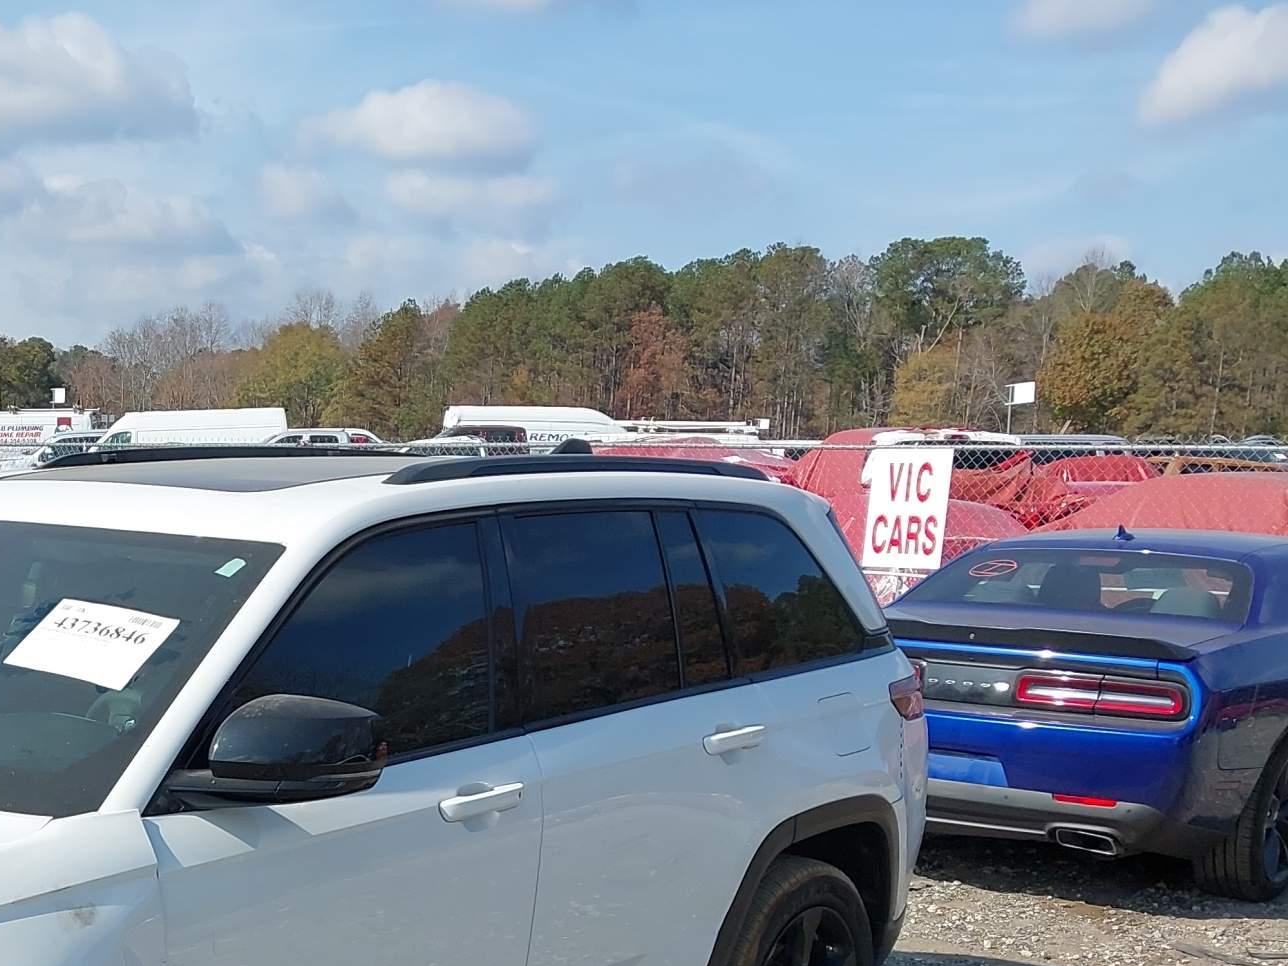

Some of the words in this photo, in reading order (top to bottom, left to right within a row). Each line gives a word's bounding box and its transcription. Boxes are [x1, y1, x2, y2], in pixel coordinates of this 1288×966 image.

[889, 462, 934, 503] VIC
[871, 514, 939, 556] CARS
[53, 616, 150, 645] 43736846
